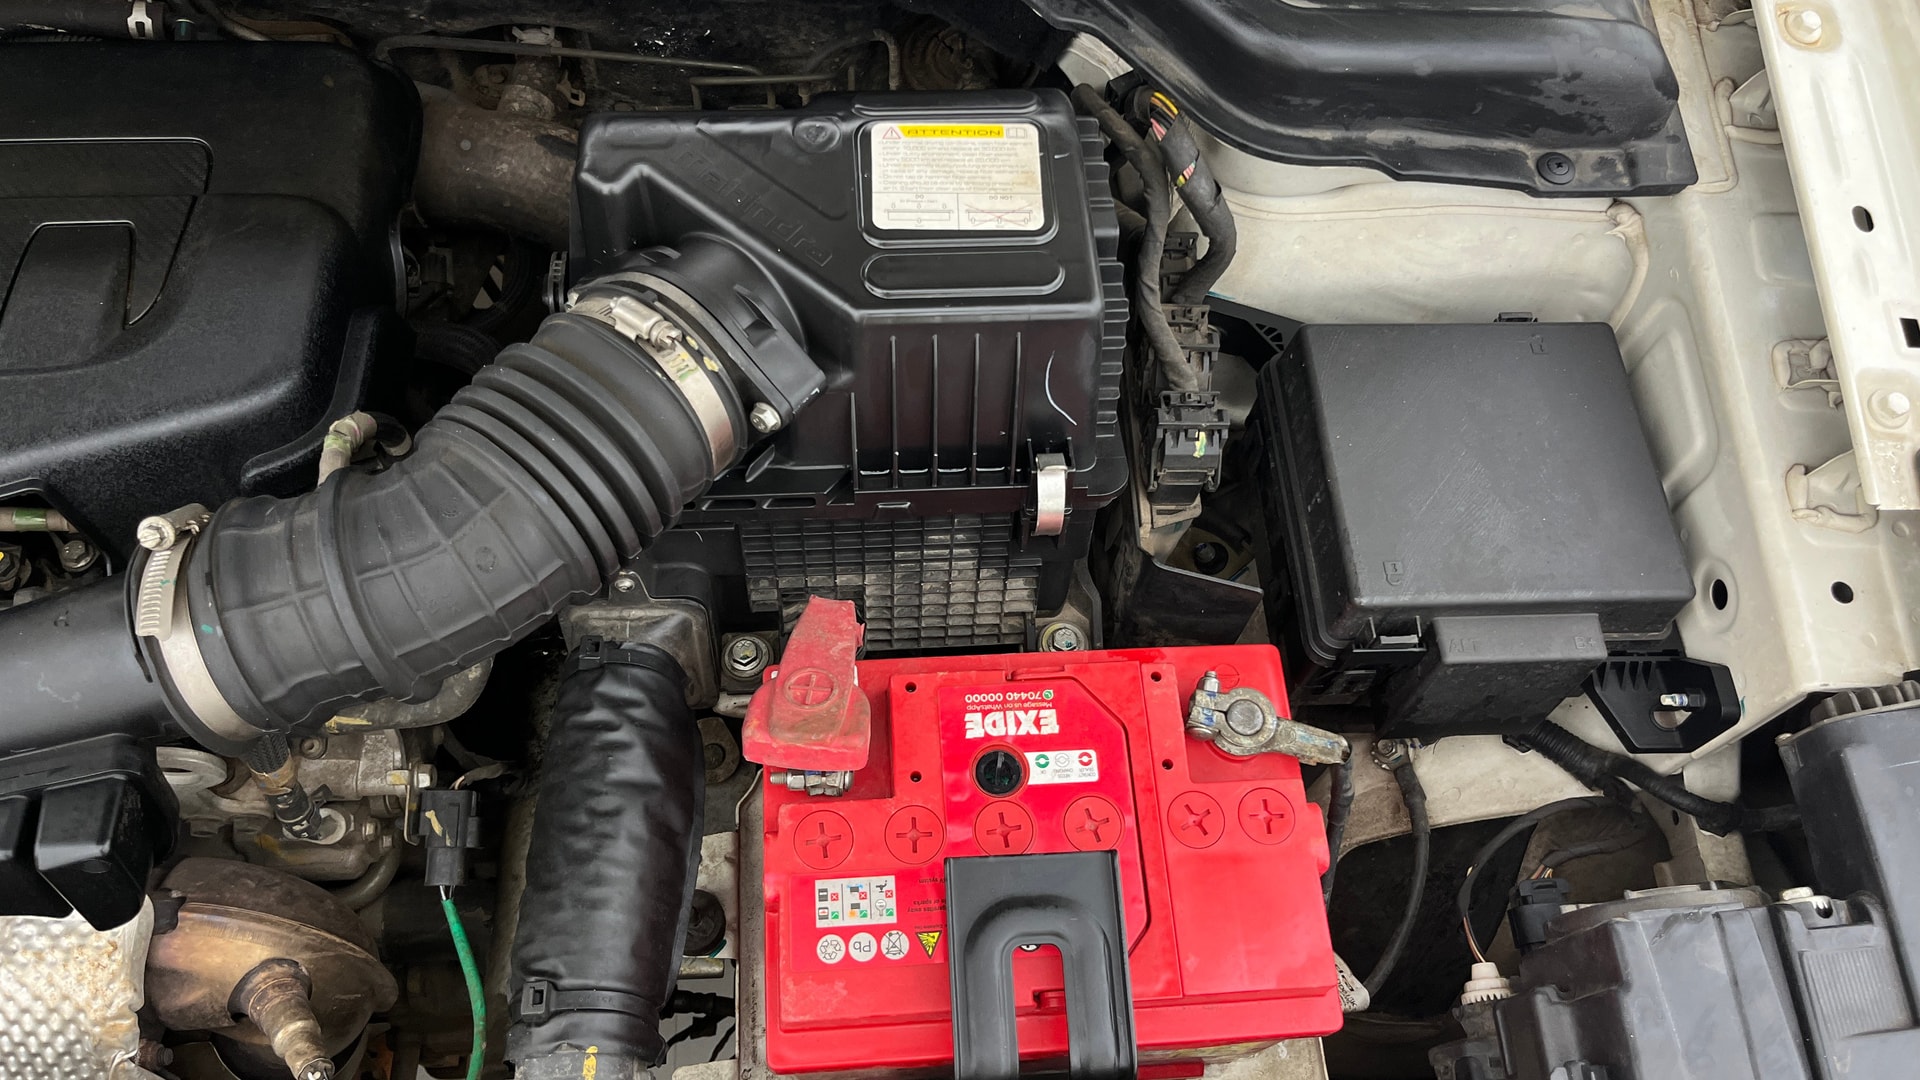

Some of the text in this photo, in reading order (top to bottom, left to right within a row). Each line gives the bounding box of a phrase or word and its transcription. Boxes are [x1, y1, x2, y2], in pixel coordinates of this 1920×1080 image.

[907, 128, 1001, 136] ATTENTION
[1449, 638, 1479, 653] ALT
[1573, 635, 1596, 649] B+
[965, 690, 1042, 703] 70440 00000
[964, 709, 1060, 739] EXIDE
[853, 940, 872, 953] Pb
